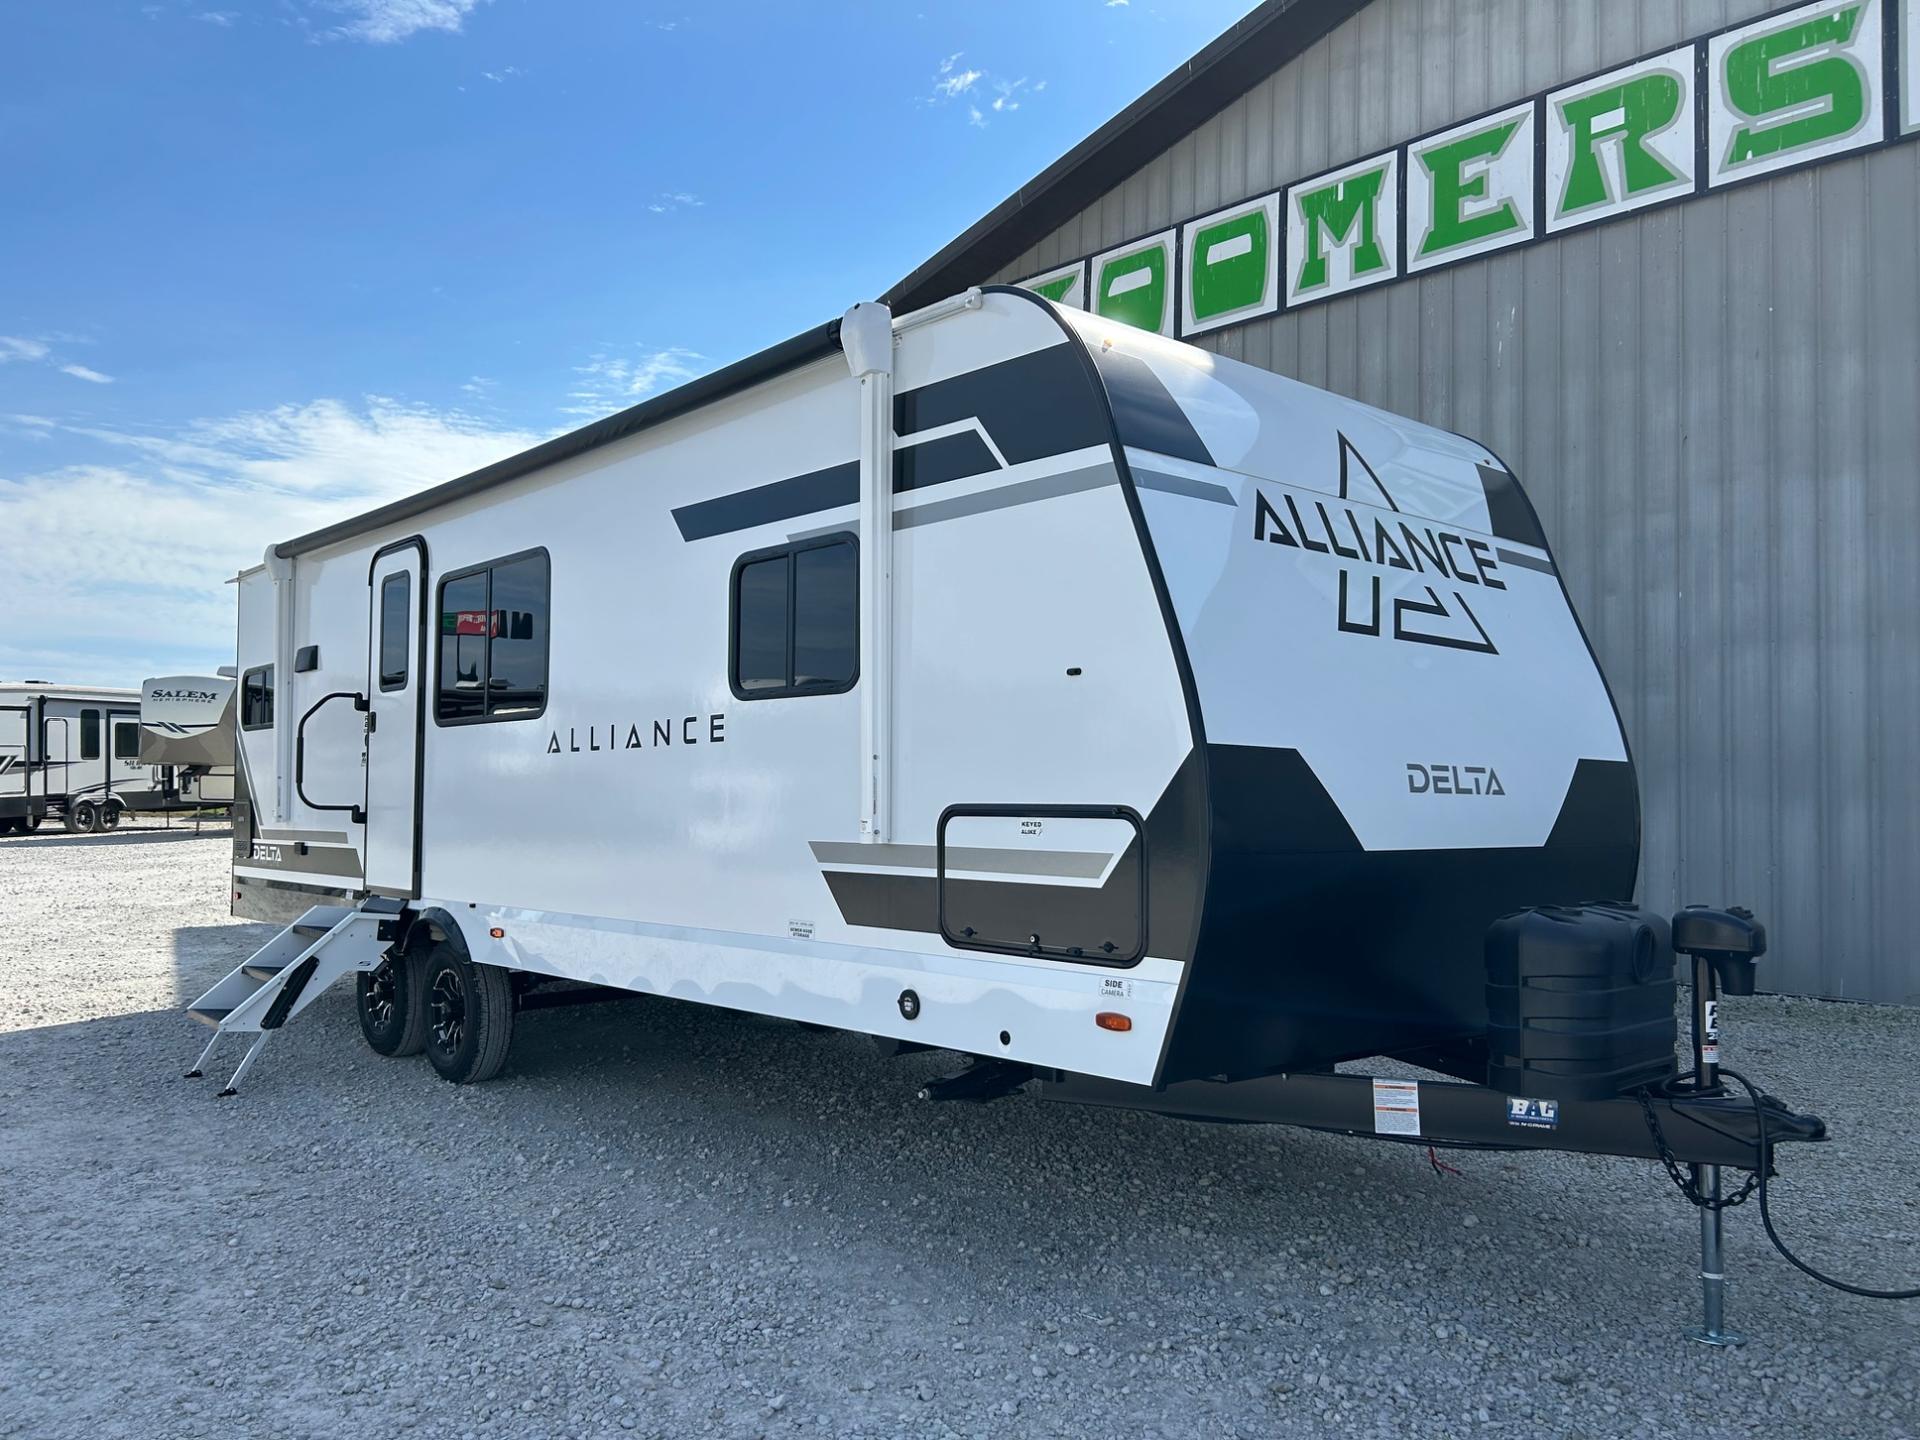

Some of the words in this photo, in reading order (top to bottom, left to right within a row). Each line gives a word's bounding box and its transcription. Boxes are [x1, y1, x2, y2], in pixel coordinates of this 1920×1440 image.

[1008, 2, 1871, 334] OOMERS
[1254, 488, 1507, 591] ALLIANCE
[151, 689, 218, 700] SALEM
[547, 713, 725, 754] ALLIANCE
[1406, 763, 1505, 796] DELTA
[253, 844, 282, 862] DELTA
[1101, 988, 1124, 997] CAMERA
[1105, 979, 1123, 989] SIDE
